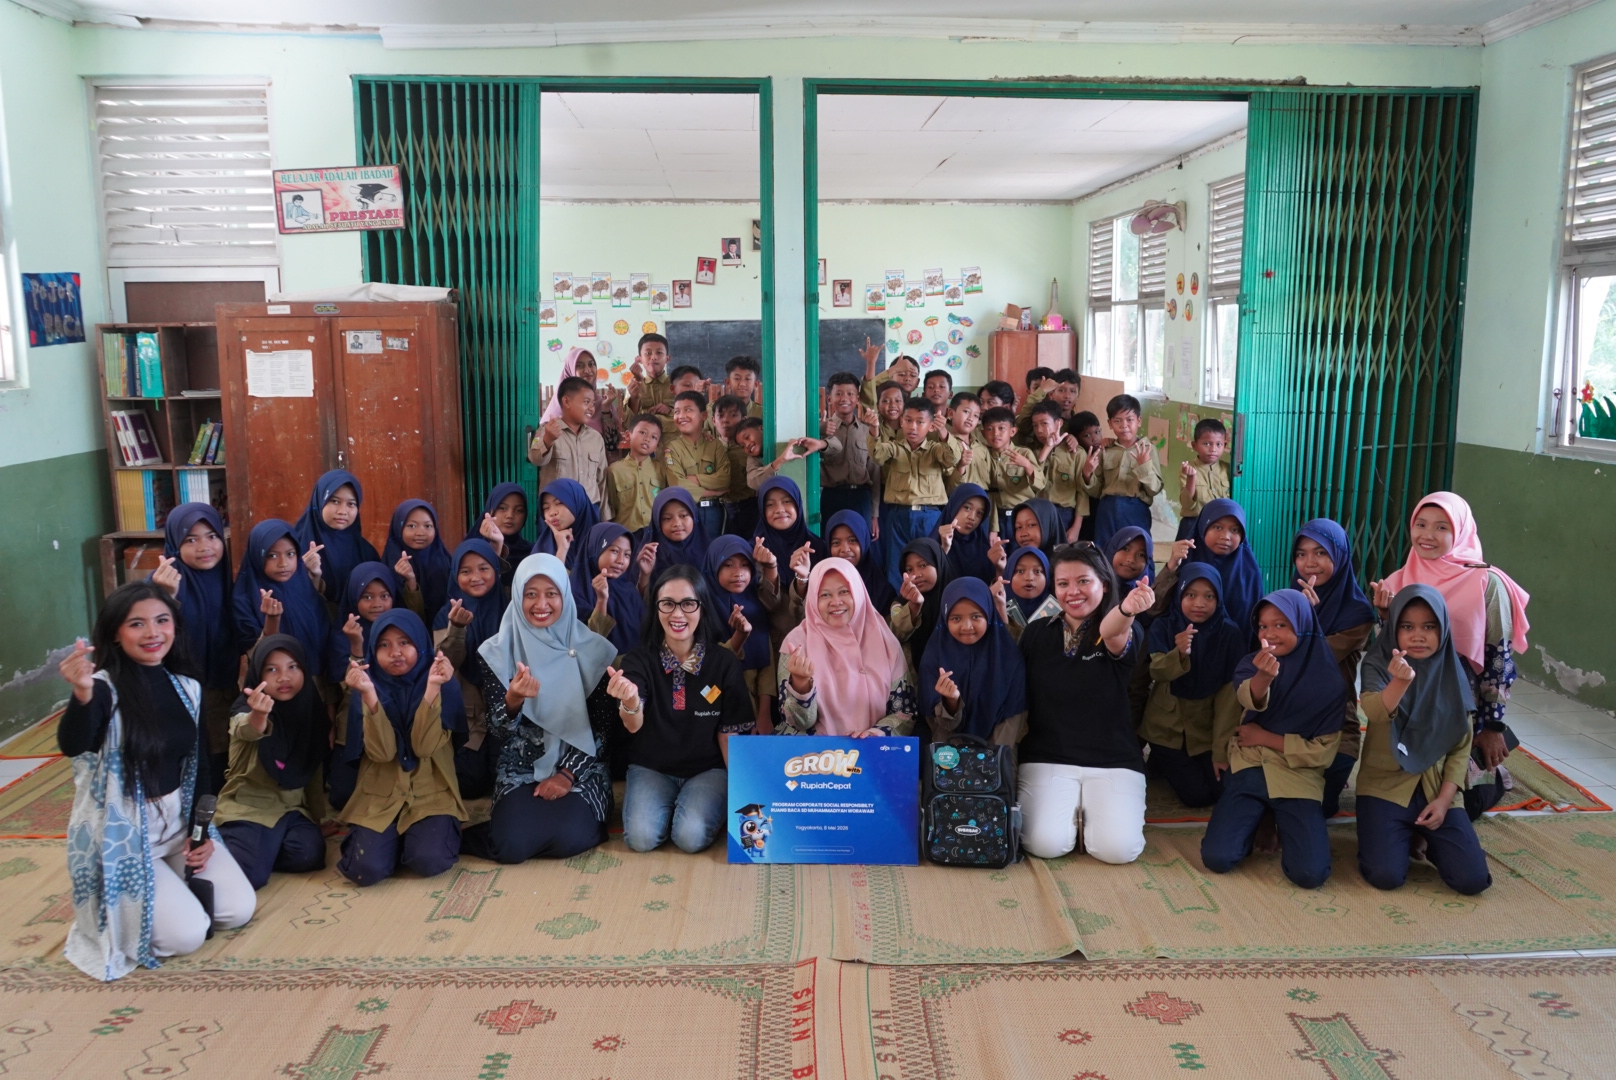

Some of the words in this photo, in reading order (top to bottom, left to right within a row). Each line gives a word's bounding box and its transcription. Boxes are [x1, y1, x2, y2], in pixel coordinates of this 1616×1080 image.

[281, 173, 321, 184] BELAJAR
[323, 171, 358, 182] ADALAH
[360, 169, 394, 180] IBADAH
[329, 209, 400, 222] PRESTASI
[786, 751, 857, 775] GROW
[800, 781, 852, 790] RupiahCepat
[792, 987, 812, 1042] SWAN
[871, 1009, 898, 1063] SWAN
